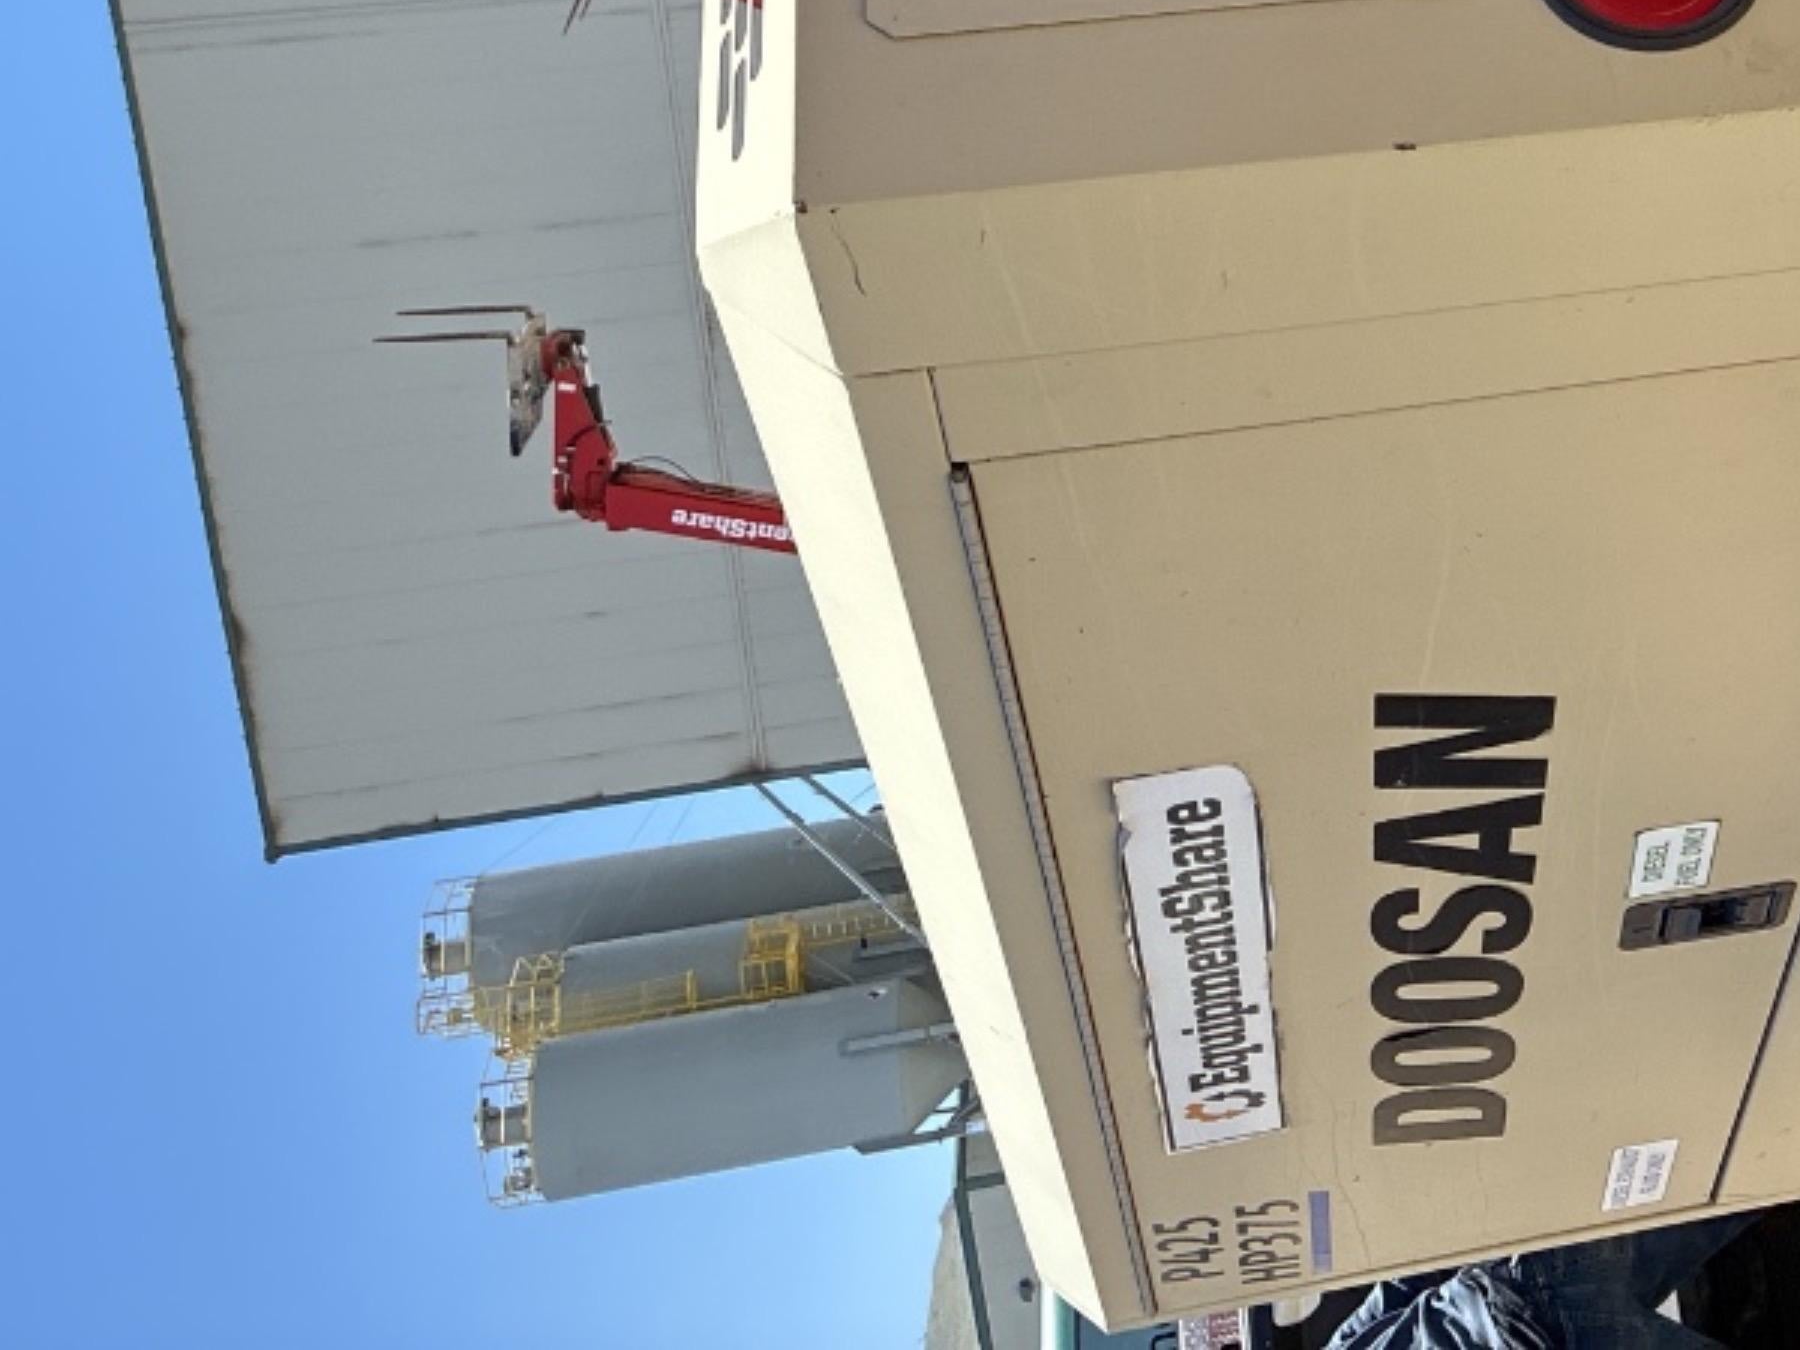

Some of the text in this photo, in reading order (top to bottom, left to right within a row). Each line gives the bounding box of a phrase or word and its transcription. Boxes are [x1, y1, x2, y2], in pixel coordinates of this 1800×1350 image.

[1162, 798, 1262, 1090] EquipmentShare
[1369, 692, 1556, 1146] DOOSAN
[1152, 1217, 1226, 1283] P425
[1234, 1200, 1302, 1284] HP375
